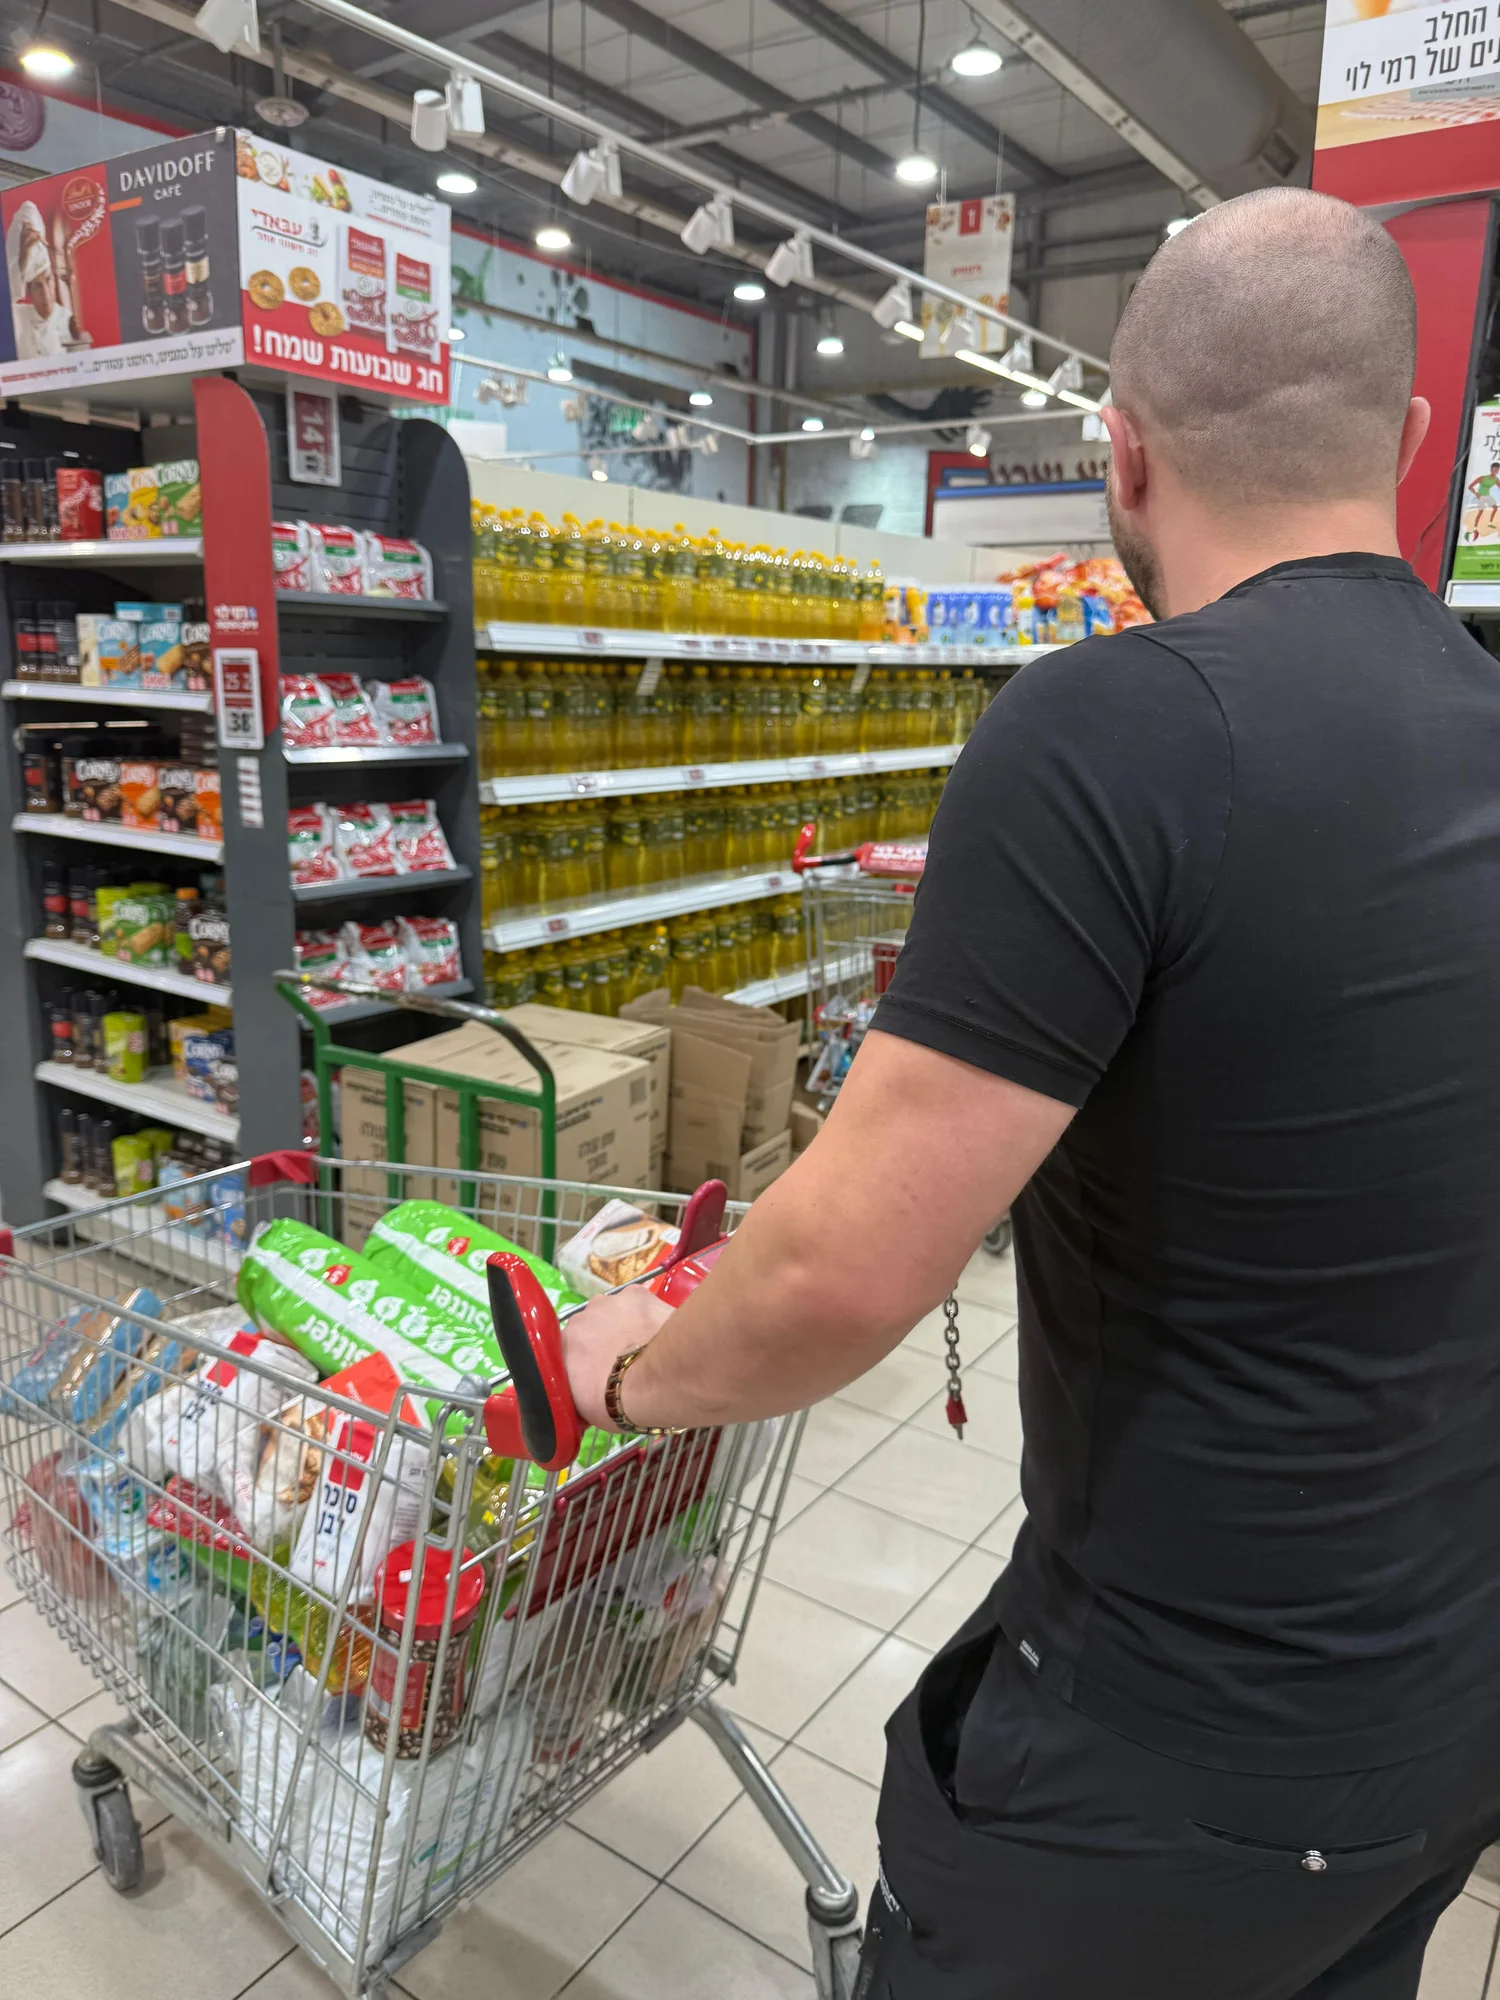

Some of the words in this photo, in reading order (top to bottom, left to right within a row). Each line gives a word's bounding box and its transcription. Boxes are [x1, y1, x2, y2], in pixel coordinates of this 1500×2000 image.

[1424, 6, 1488, 44] החלב
[1345, 60, 1372, 92] לוי
[1380, 54, 1416, 85] רמי
[1426, 45, 1461, 77] של
[120, 150, 216, 192] DAVIDOFF
[250, 208, 303, 236] עבאדי
[252, 324, 324, 366] שמח!
[329, 344, 412, 387] שבועות
[416, 365, 444, 394] חג
[324, 1482, 358, 1514] סכר
